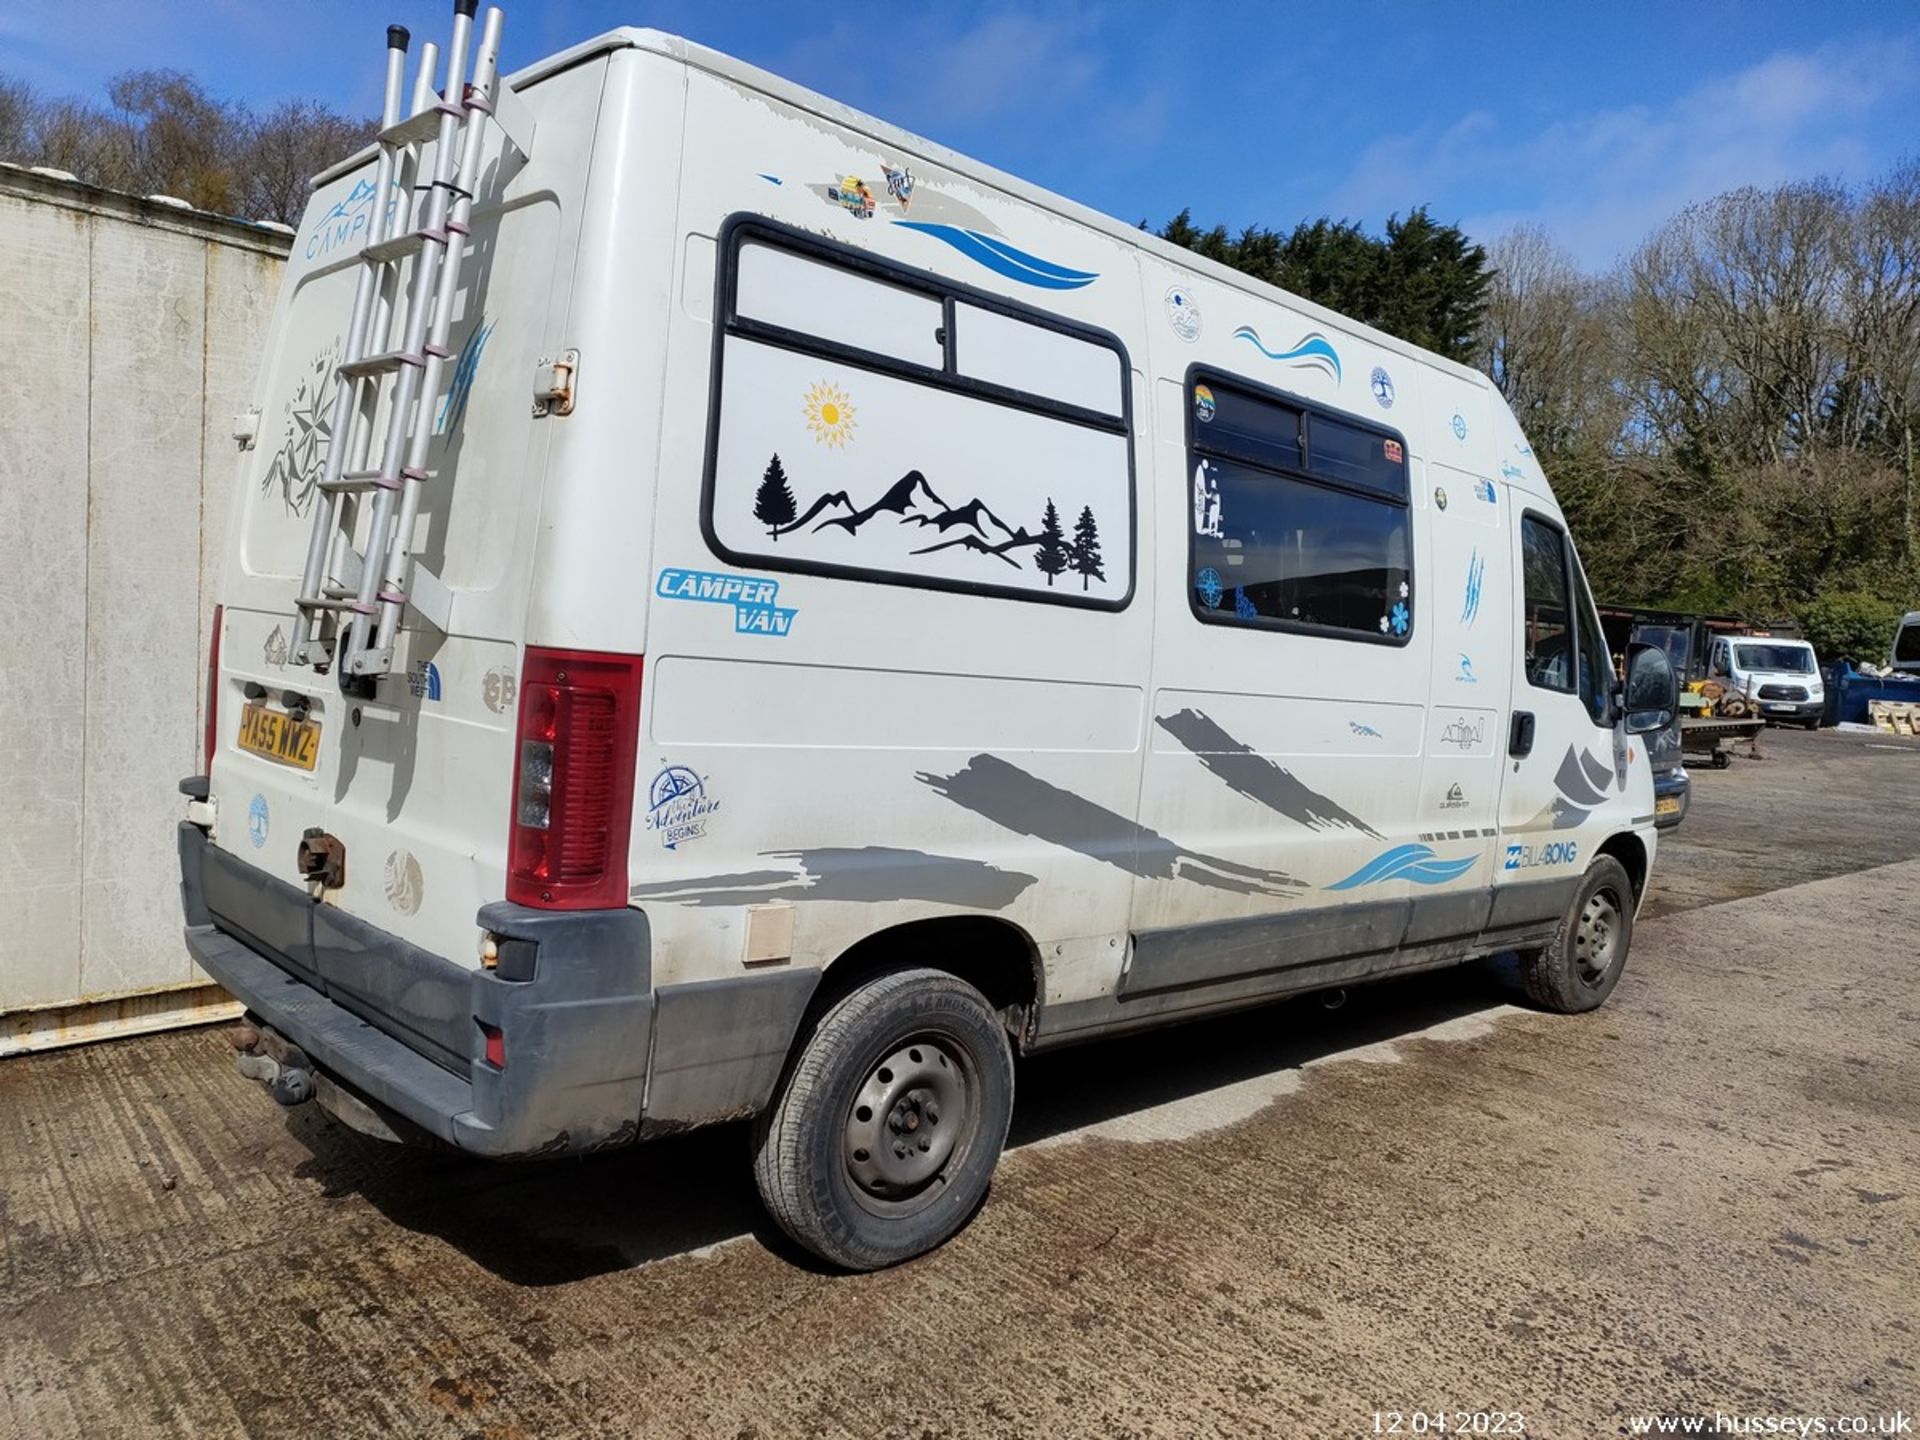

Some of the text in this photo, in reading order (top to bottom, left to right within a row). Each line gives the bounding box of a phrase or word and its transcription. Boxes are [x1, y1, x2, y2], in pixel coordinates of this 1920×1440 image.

[305, 201, 397, 260] CAMPR
[659, 572, 776, 604] CAMPER
[738, 607, 790, 633] VAN
[666, 823, 701, 842] BEGINS
[1522, 841, 1577, 867] BILLABONG
